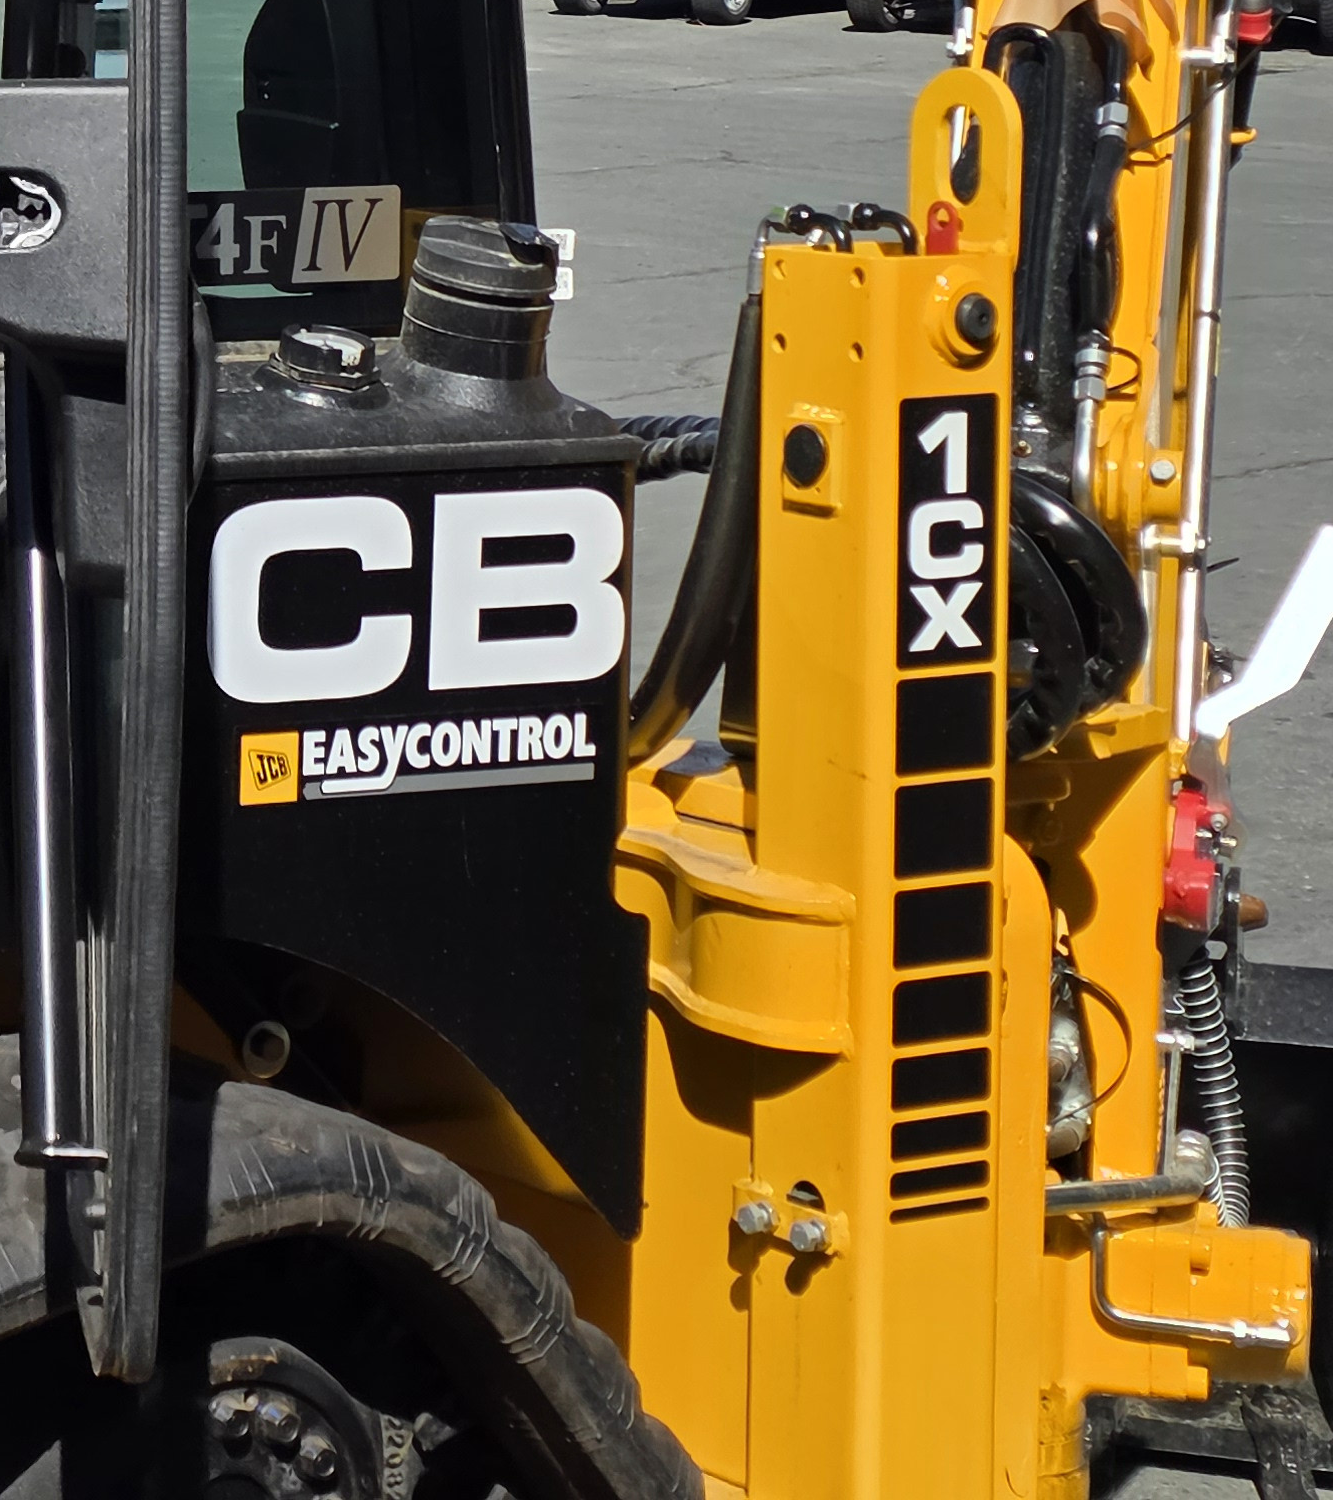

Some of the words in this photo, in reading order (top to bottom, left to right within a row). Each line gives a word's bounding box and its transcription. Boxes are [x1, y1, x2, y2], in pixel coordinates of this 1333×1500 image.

[300, 197, 384, 273] IV
[206, 486, 626, 705] CB
[907, 411, 985, 653] 1CX
[256, 752, 288, 784] JCB
